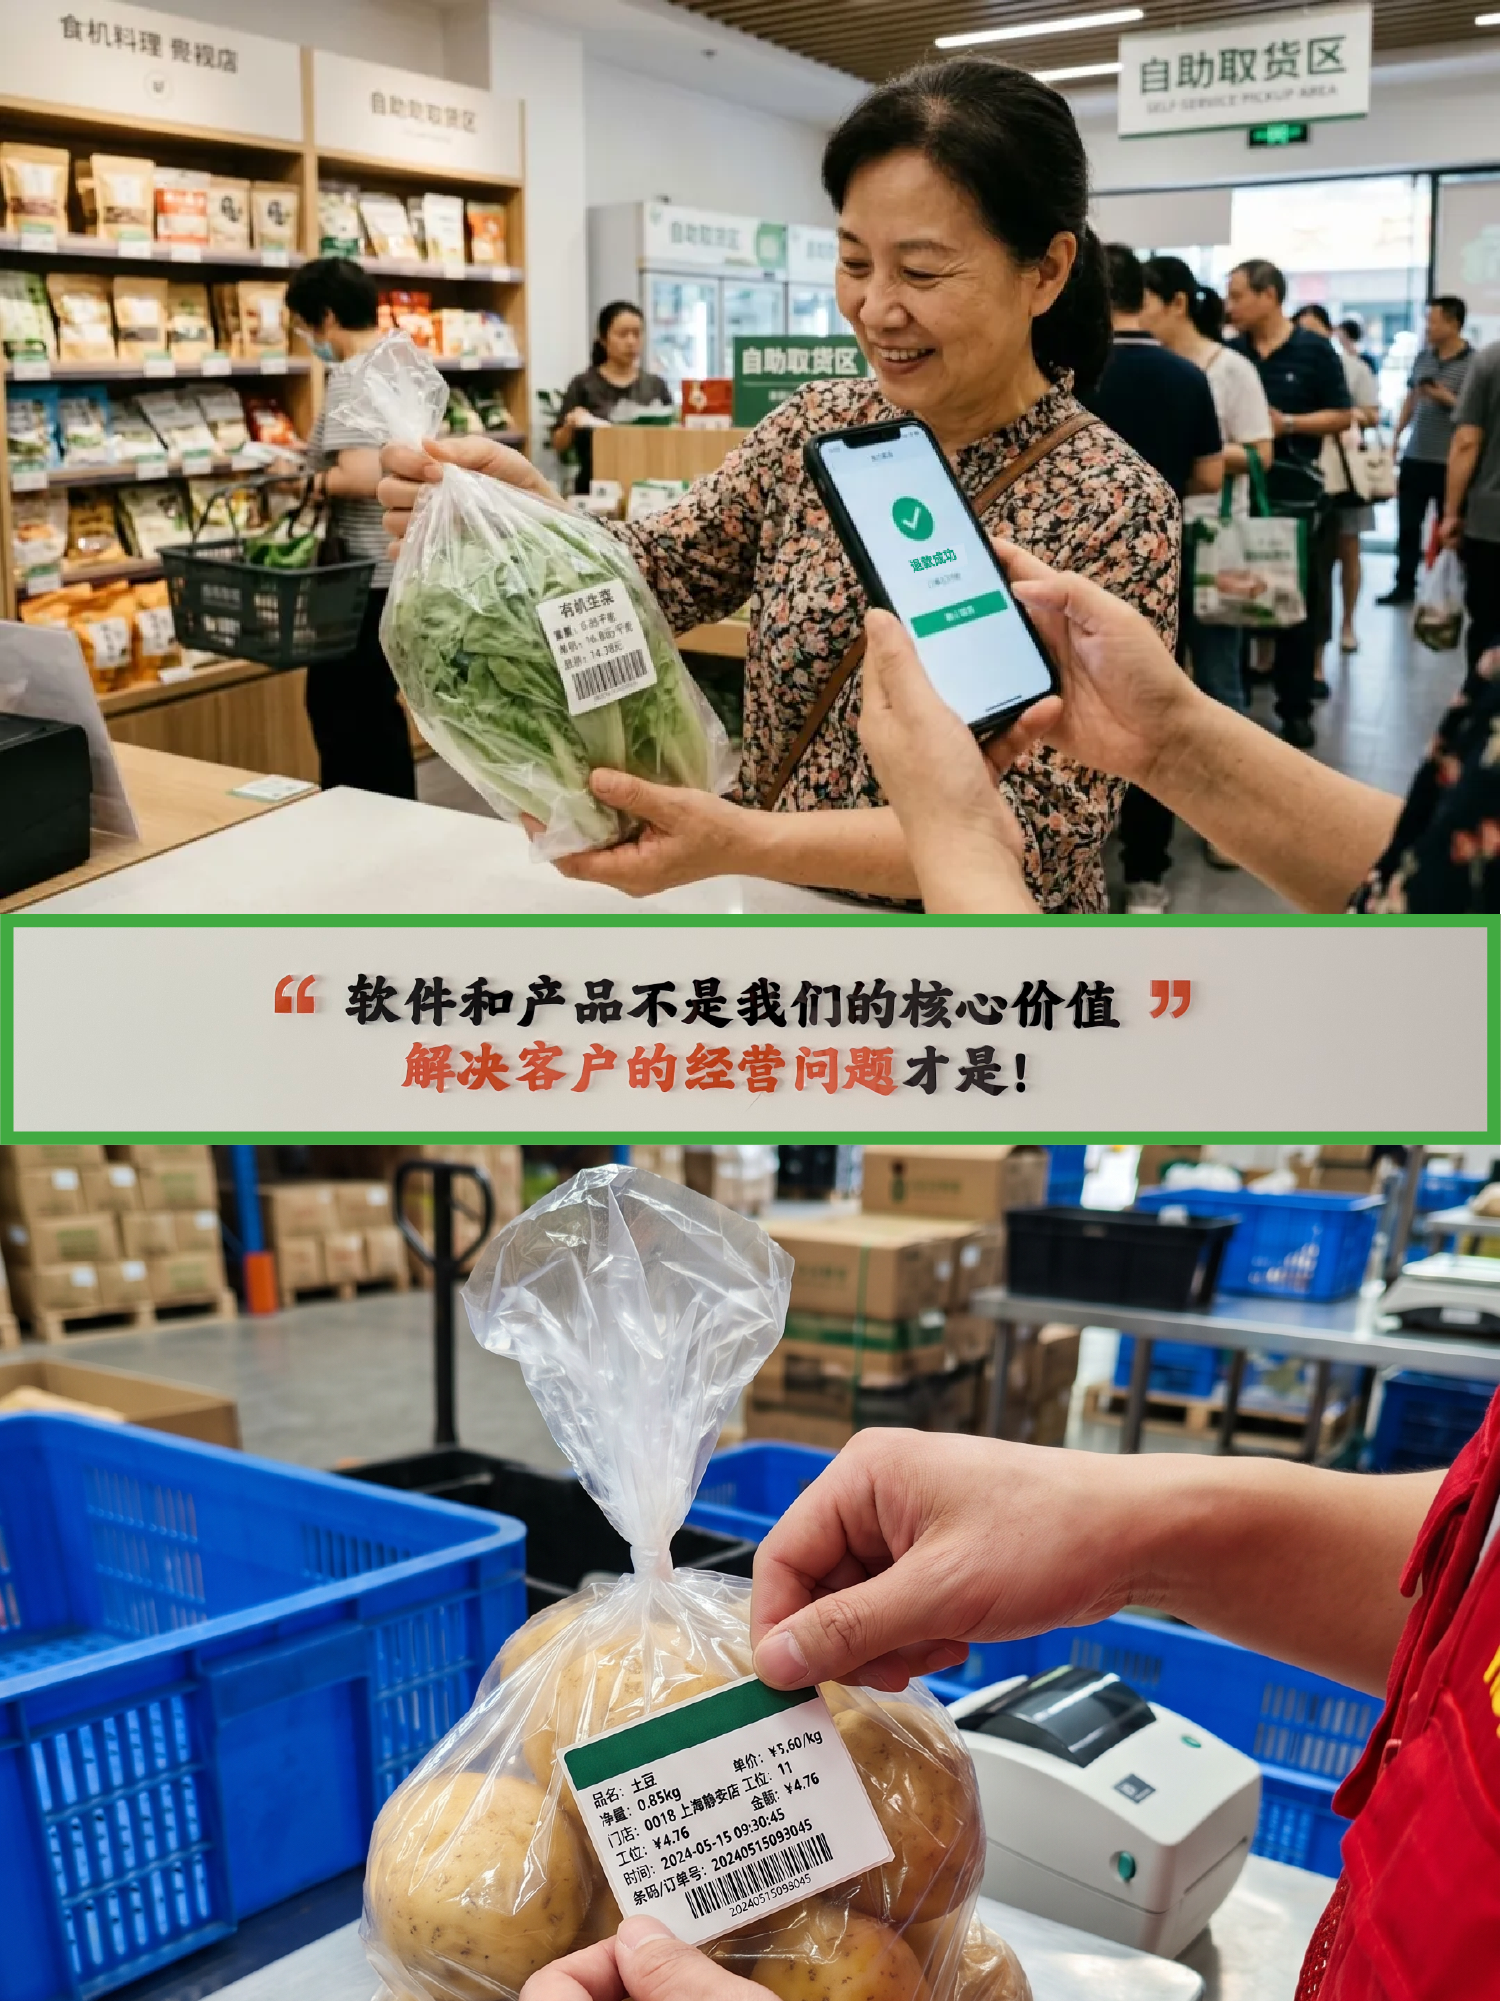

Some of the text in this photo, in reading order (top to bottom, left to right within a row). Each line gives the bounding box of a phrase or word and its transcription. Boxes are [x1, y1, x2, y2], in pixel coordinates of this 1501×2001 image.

[1140, 35, 1346, 94] 自助取货区
[742, 346, 859, 375] 自助取货区
[630, 1772, 657, 1794] 土豆
[637, 1787, 682, 1811] 0.85kg
[644, 1809, 677, 1831] 0018
[777, 1761, 793, 1775] 11
[660, 1830, 732, 1871] 2024-05-15
[733, 1807, 785, 1839] 09:30:45
[711, 1818, 813, 1871] 20240515093045
